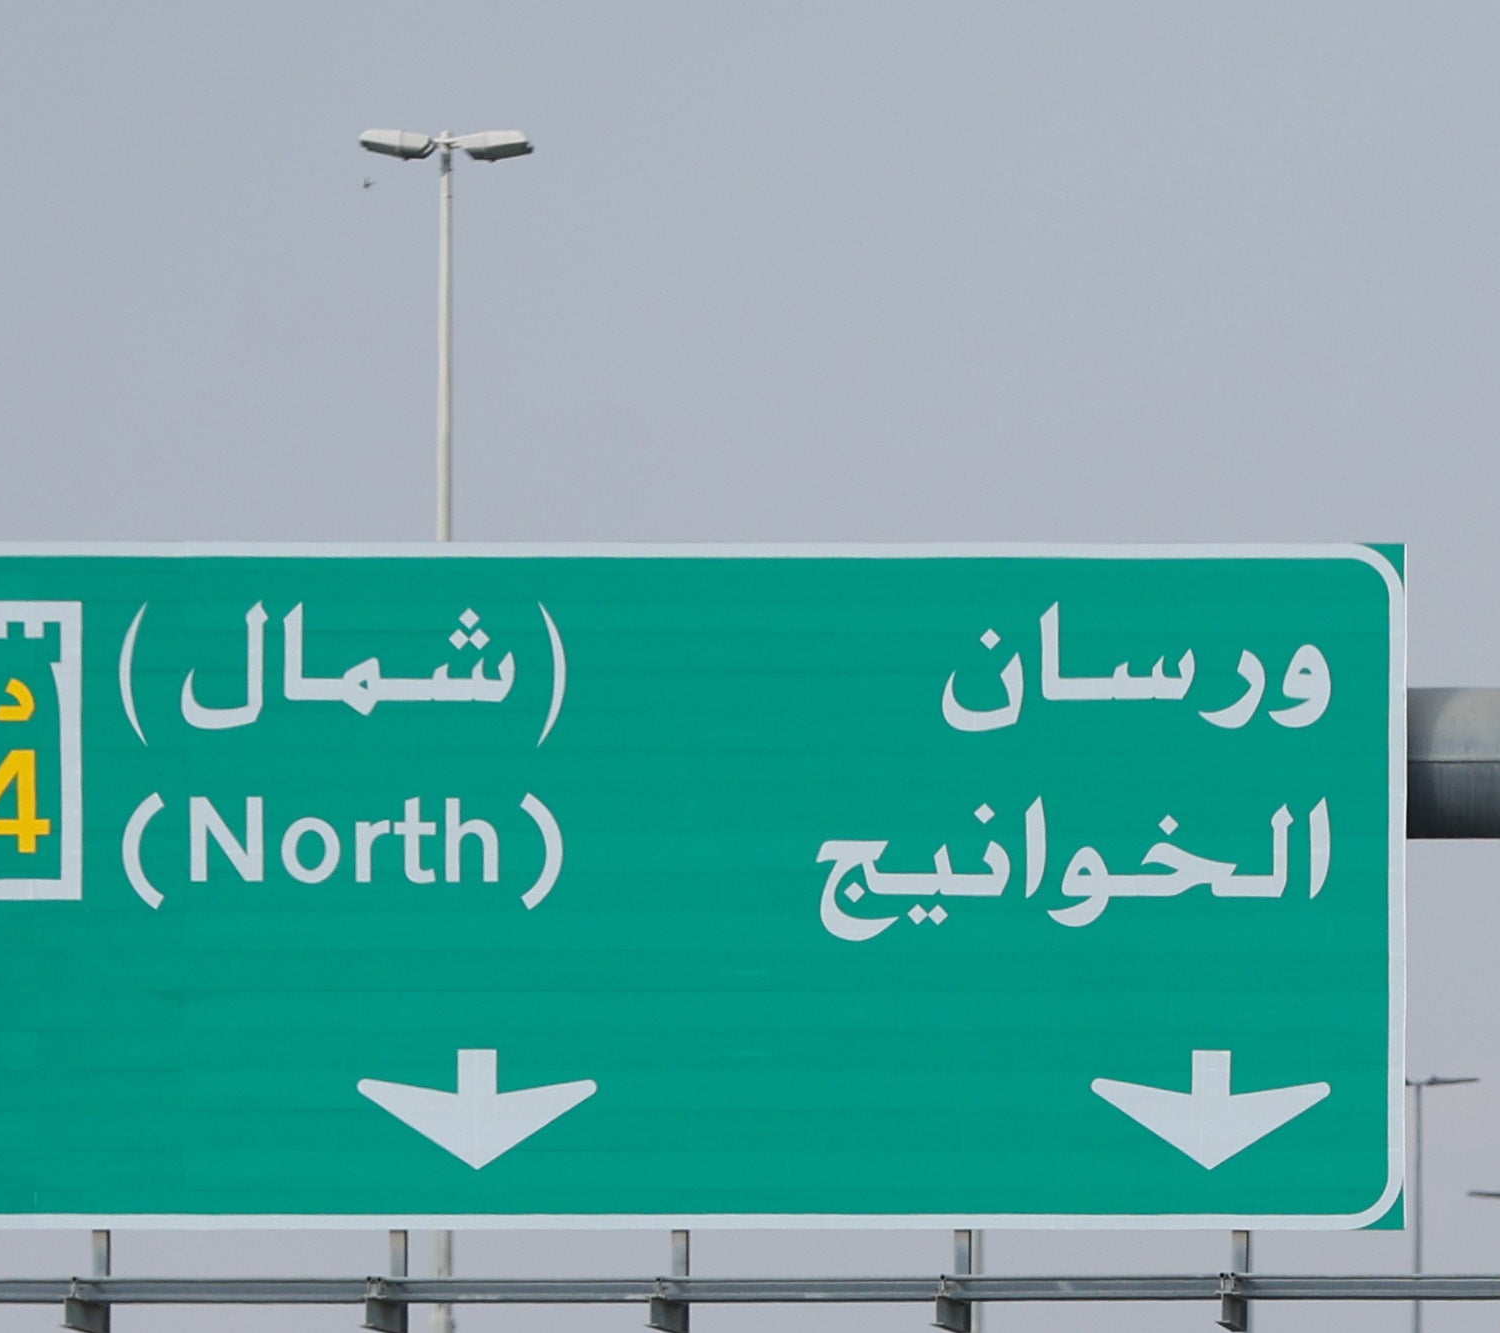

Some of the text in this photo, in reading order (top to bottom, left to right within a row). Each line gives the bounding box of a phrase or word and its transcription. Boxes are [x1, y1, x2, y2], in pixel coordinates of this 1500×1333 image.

[119, 602, 566, 744] (شمال)
[942, 602, 1331, 731] ورسان
[122, 793, 563, 909] (North)
[816, 797, 1330, 941] الخوانيج
